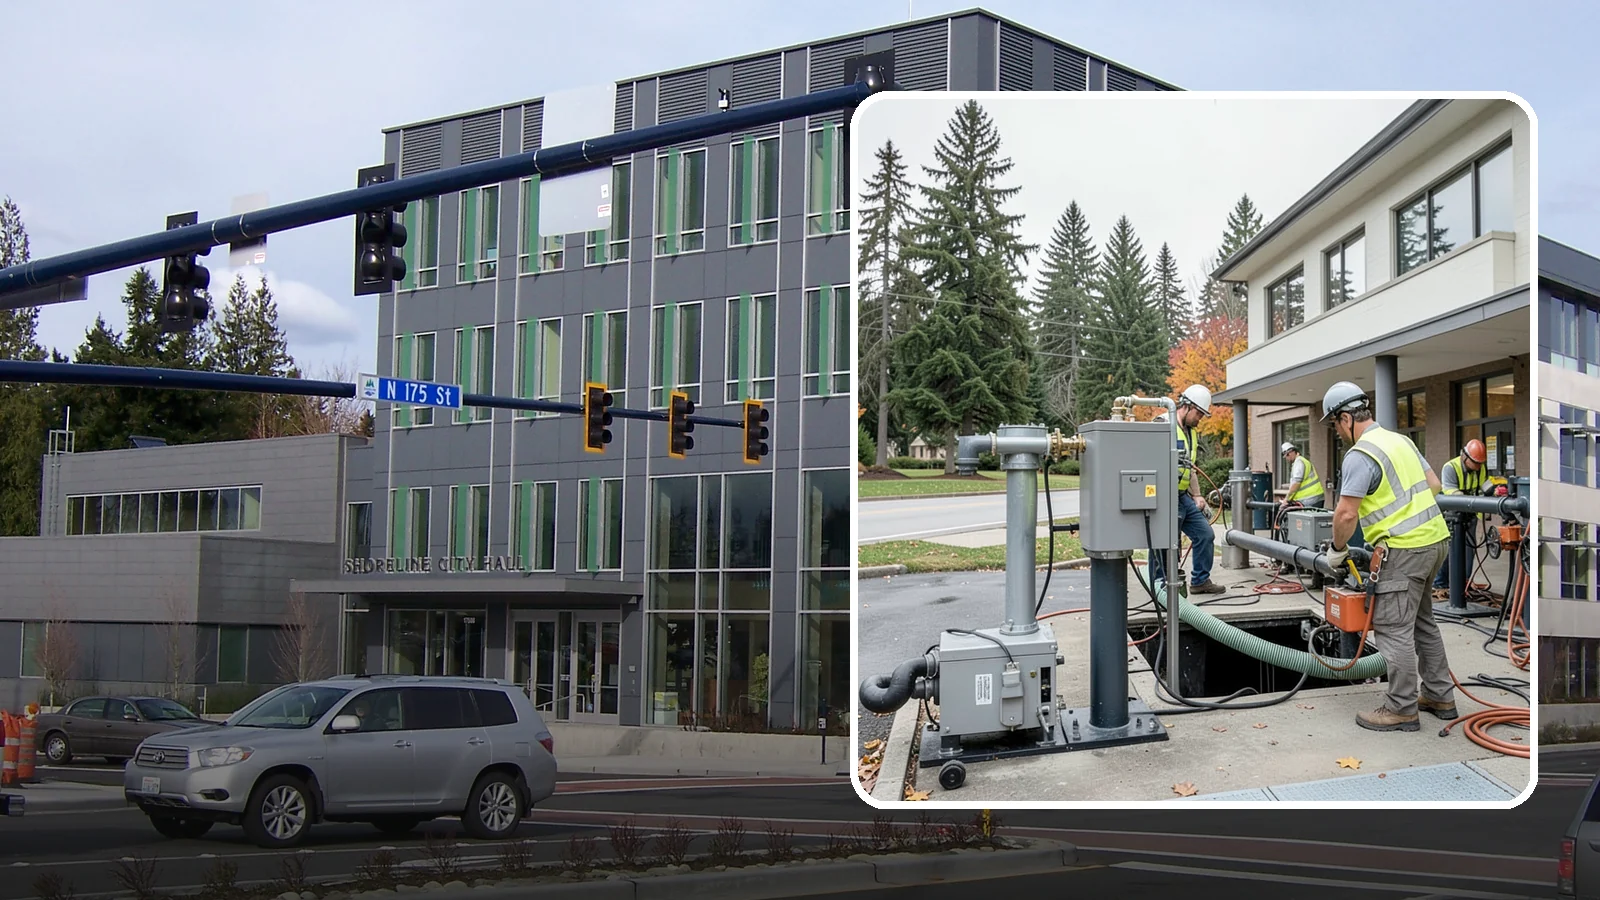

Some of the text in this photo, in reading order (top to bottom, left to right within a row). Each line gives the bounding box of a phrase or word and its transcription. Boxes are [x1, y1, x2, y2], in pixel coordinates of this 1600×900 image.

[387, 380, 451, 406] N 175 St
[344, 555, 526, 574] SHORELINE CITY HALL
